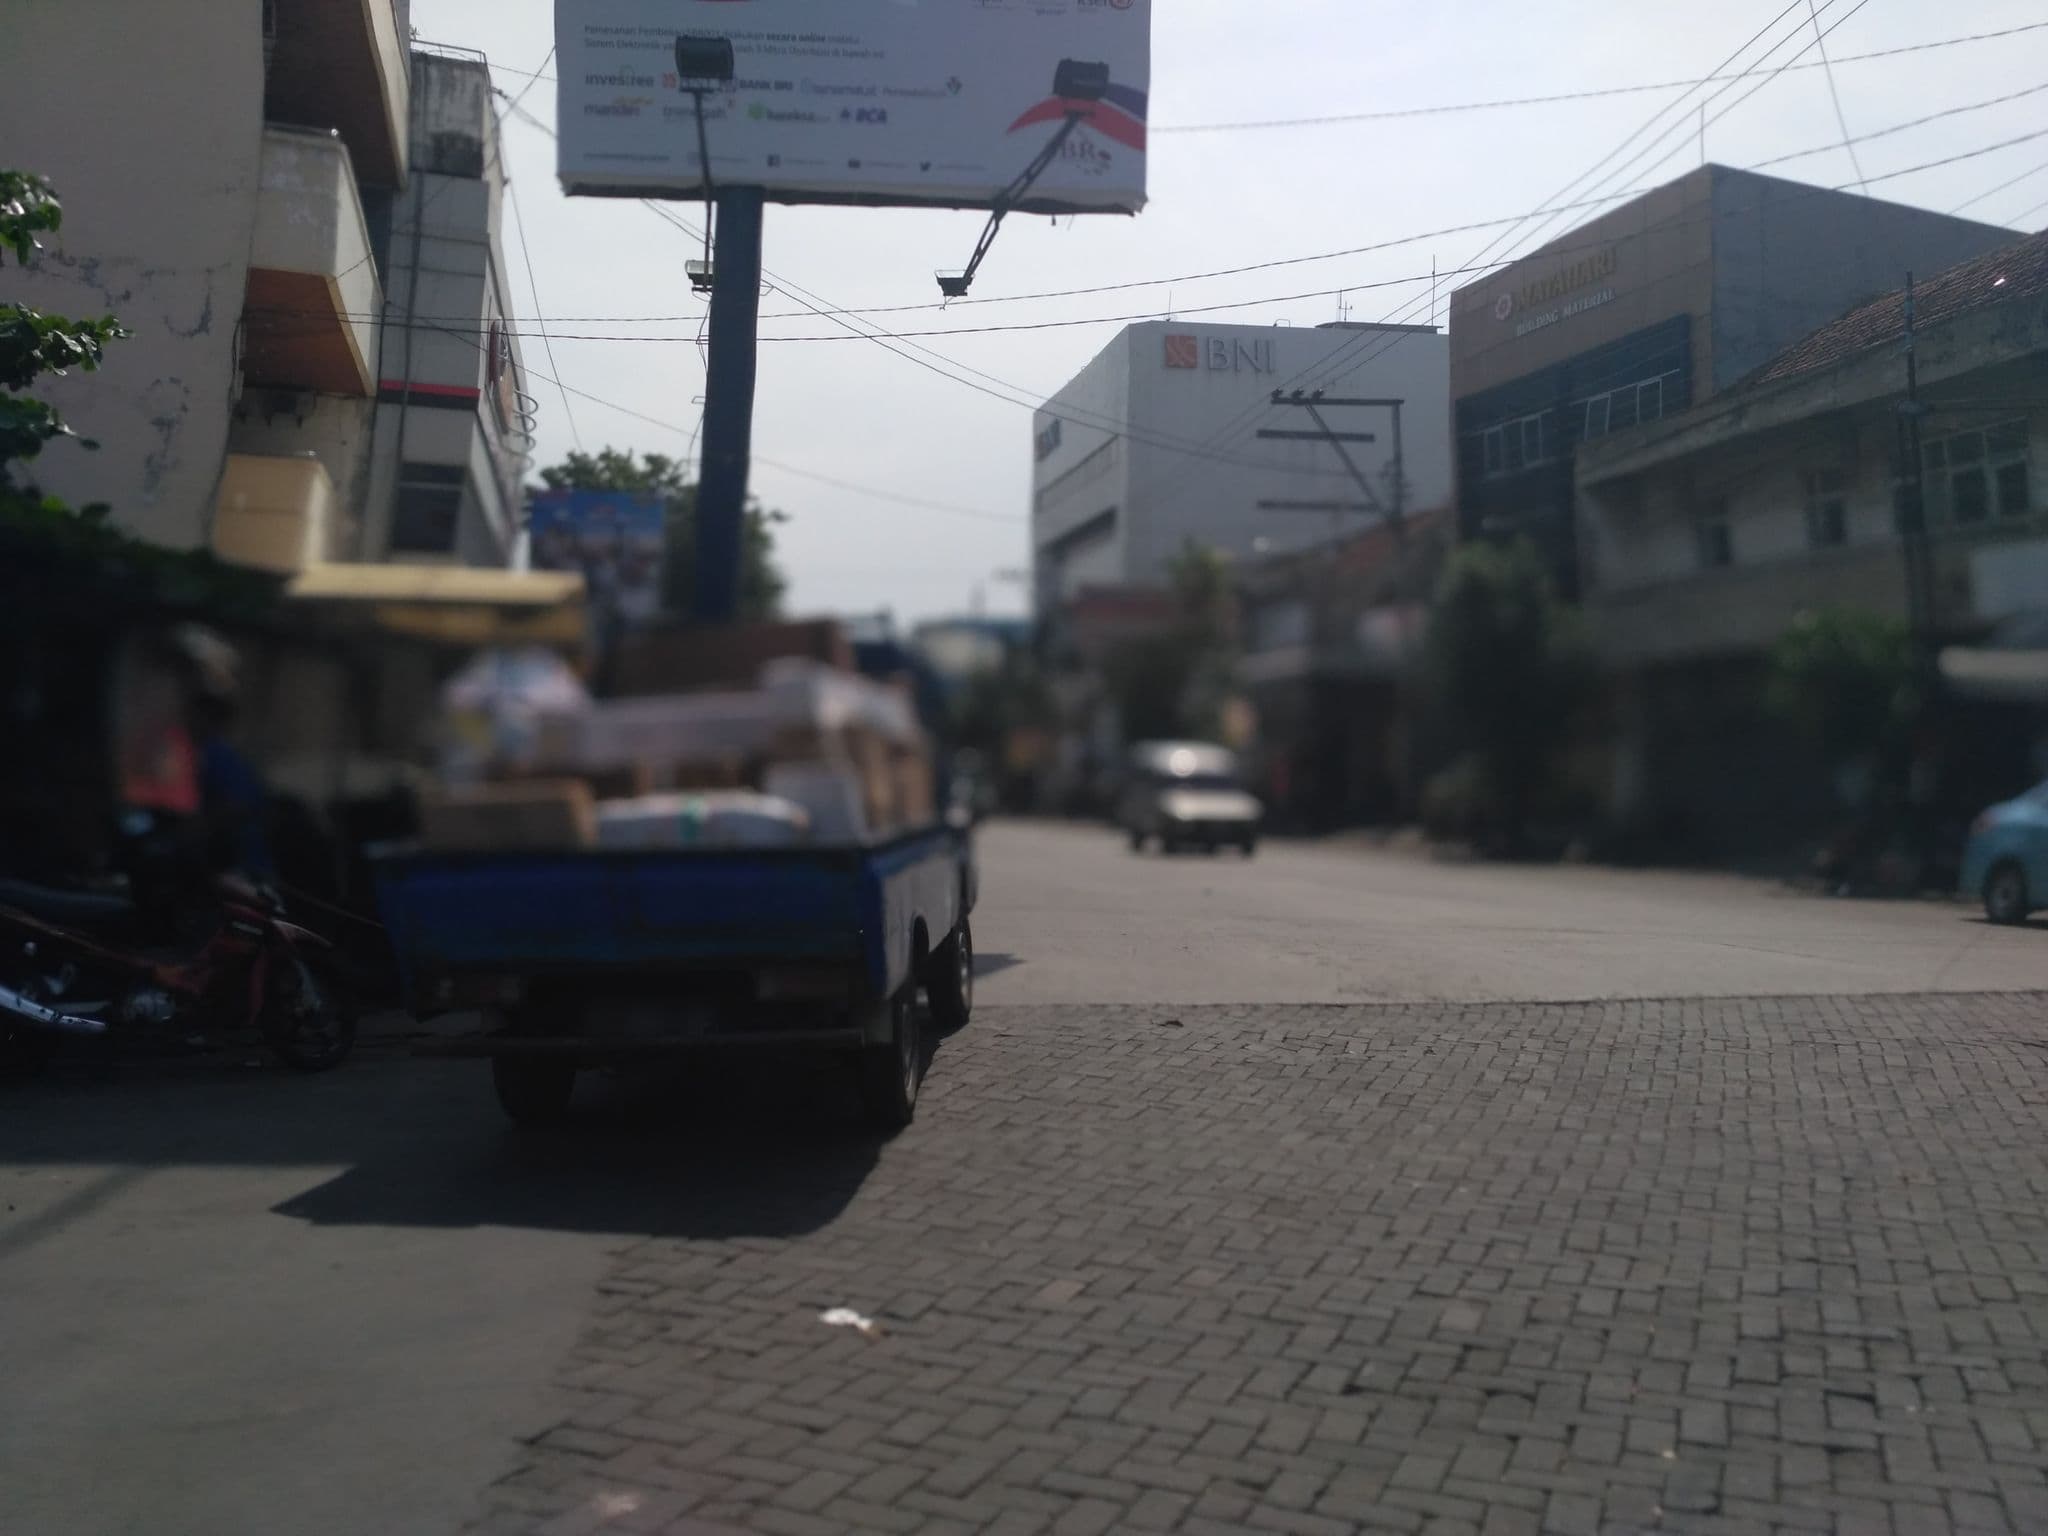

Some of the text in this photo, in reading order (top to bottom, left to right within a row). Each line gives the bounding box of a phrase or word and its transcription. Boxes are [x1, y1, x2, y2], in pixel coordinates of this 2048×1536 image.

[767, 33, 796, 42] secara
[798, 33, 826, 42] online
[1516, 310, 1560, 337] BUILDING
[1207, 335, 1277, 375] BNI
